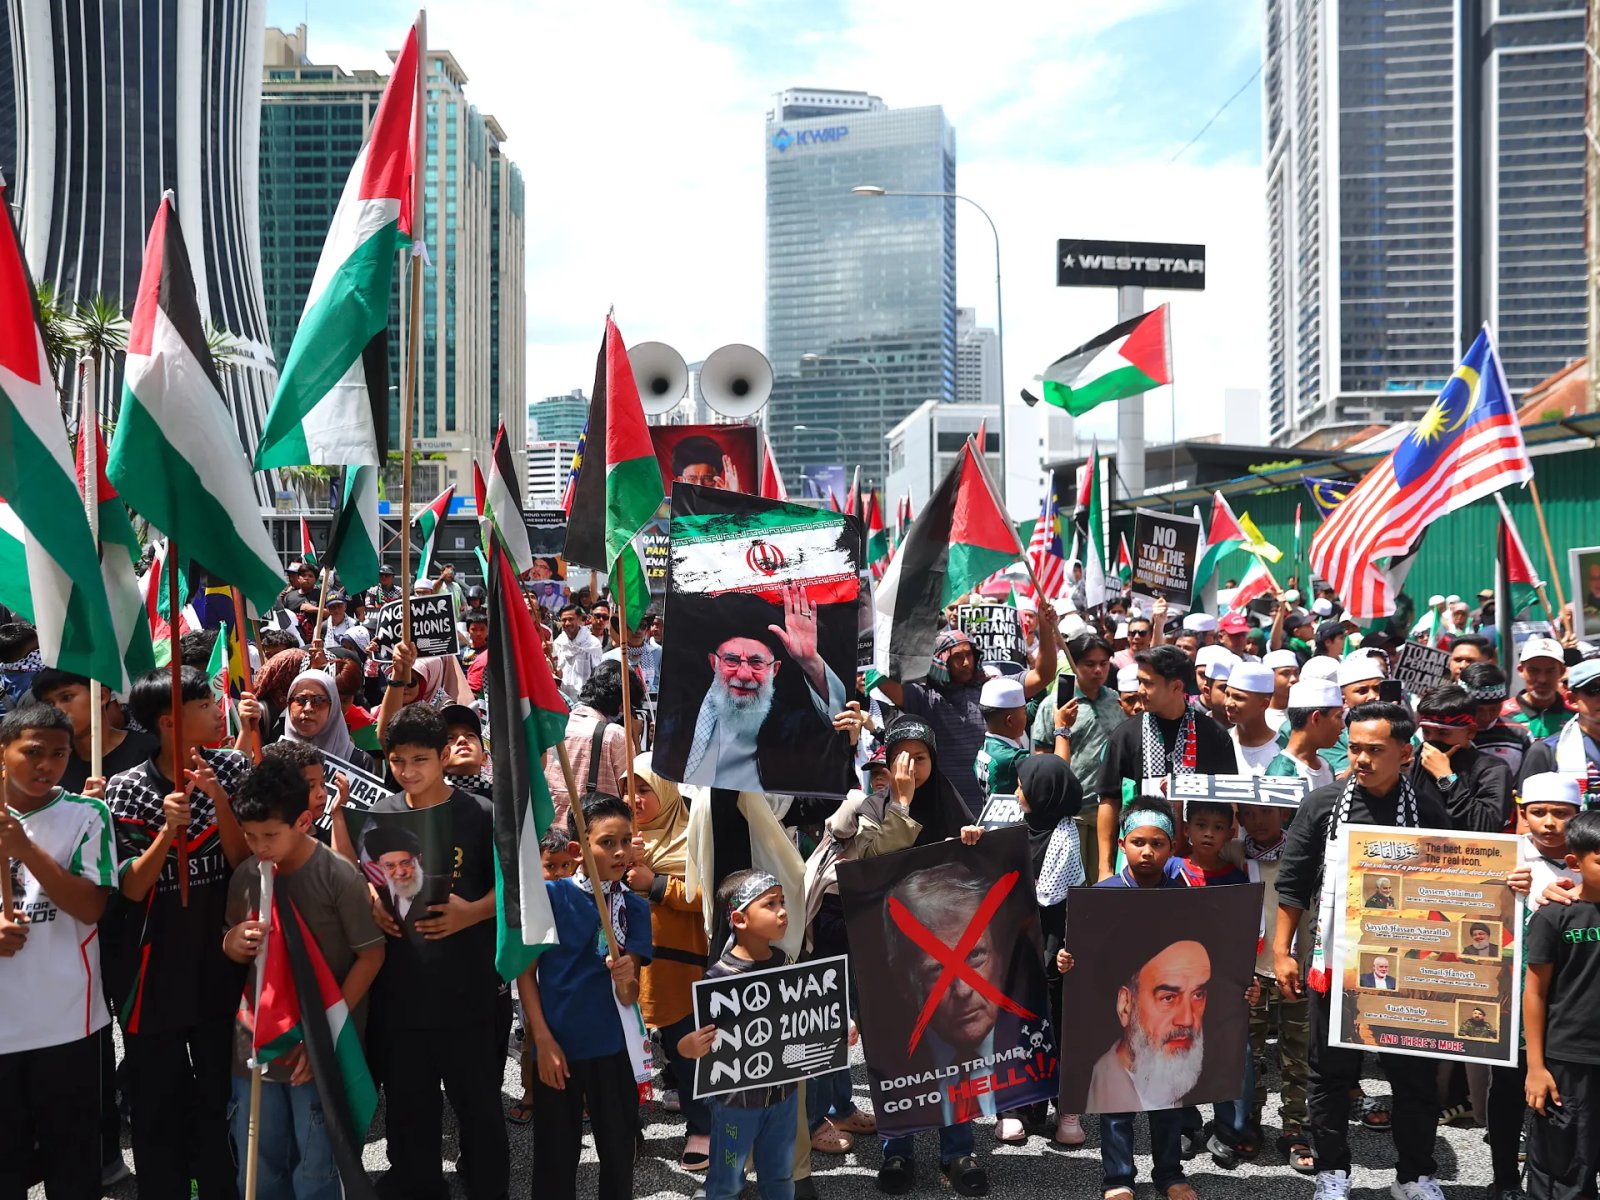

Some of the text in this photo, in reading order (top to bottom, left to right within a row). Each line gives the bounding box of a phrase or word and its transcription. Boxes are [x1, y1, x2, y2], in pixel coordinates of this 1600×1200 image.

[797, 126, 849, 145] KWAP
[1078, 254, 1205, 273] WESTSTAR
[1152, 525, 1177, 548] NO
[1142, 543, 1186, 567] TO THE
[1138, 557, 1187, 579] ISRAELI-U.S.
[1136, 568, 1188, 590] WAR ON IRAN!
[411, 599, 448, 616] WAR
[961, 607, 1015, 622] TOLAK
[412, 617, 451, 636] ZIONIS
[964, 621, 1016, 635] PERANG
[974, 635, 1017, 649] OLAK
[1407, 644, 1447, 666] TOLAK
[1403, 655, 1444, 676] PERANG
[1399, 666, 1440, 688] TOLAK
[1425, 853, 1482, 867] The real icon.
[1426, 843, 1502, 858] The best example.
[1405, 865, 1433, 873] person
[1418, 887, 1446, 897] Qassem
[26, 902, 49, 911] FOR
[1365, 923, 1450, 936] Sayyid Hassan Nasrallah
[1420, 967, 1443, 976] Ismail
[778, 968, 838, 1004] WAR
[779, 1002, 841, 1041] ZIONIS
[1380, 1033, 1398, 1045] AND
[1400, 1035, 1436, 1049] THERE'S
[880, 1064, 960, 1092] DONALD
[884, 1098, 913, 1113] GO
[915, 1091, 942, 1107] TO
